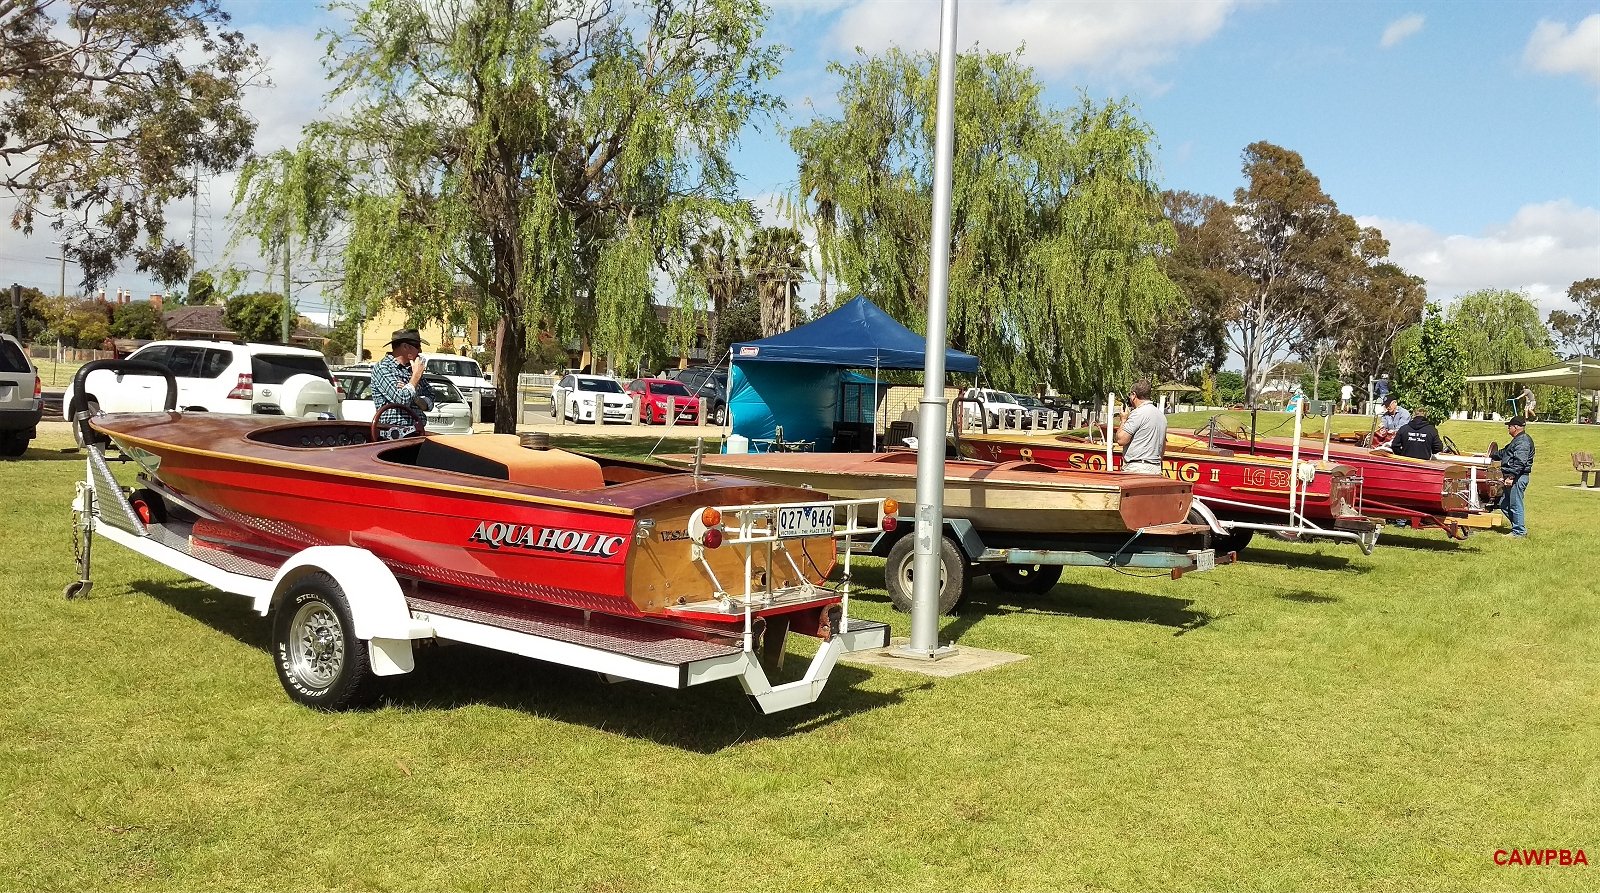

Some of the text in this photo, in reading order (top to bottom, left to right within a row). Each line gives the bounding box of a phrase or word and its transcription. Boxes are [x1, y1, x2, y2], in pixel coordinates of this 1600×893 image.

[1020, 448, 1034, 464] 8
[1243, 468, 1266, 486] LG
[781, 509, 832, 530] Q27 846
[471, 520, 625, 557] AQUAHOLIC
[279, 642, 330, 697] BRIDGESTONE
